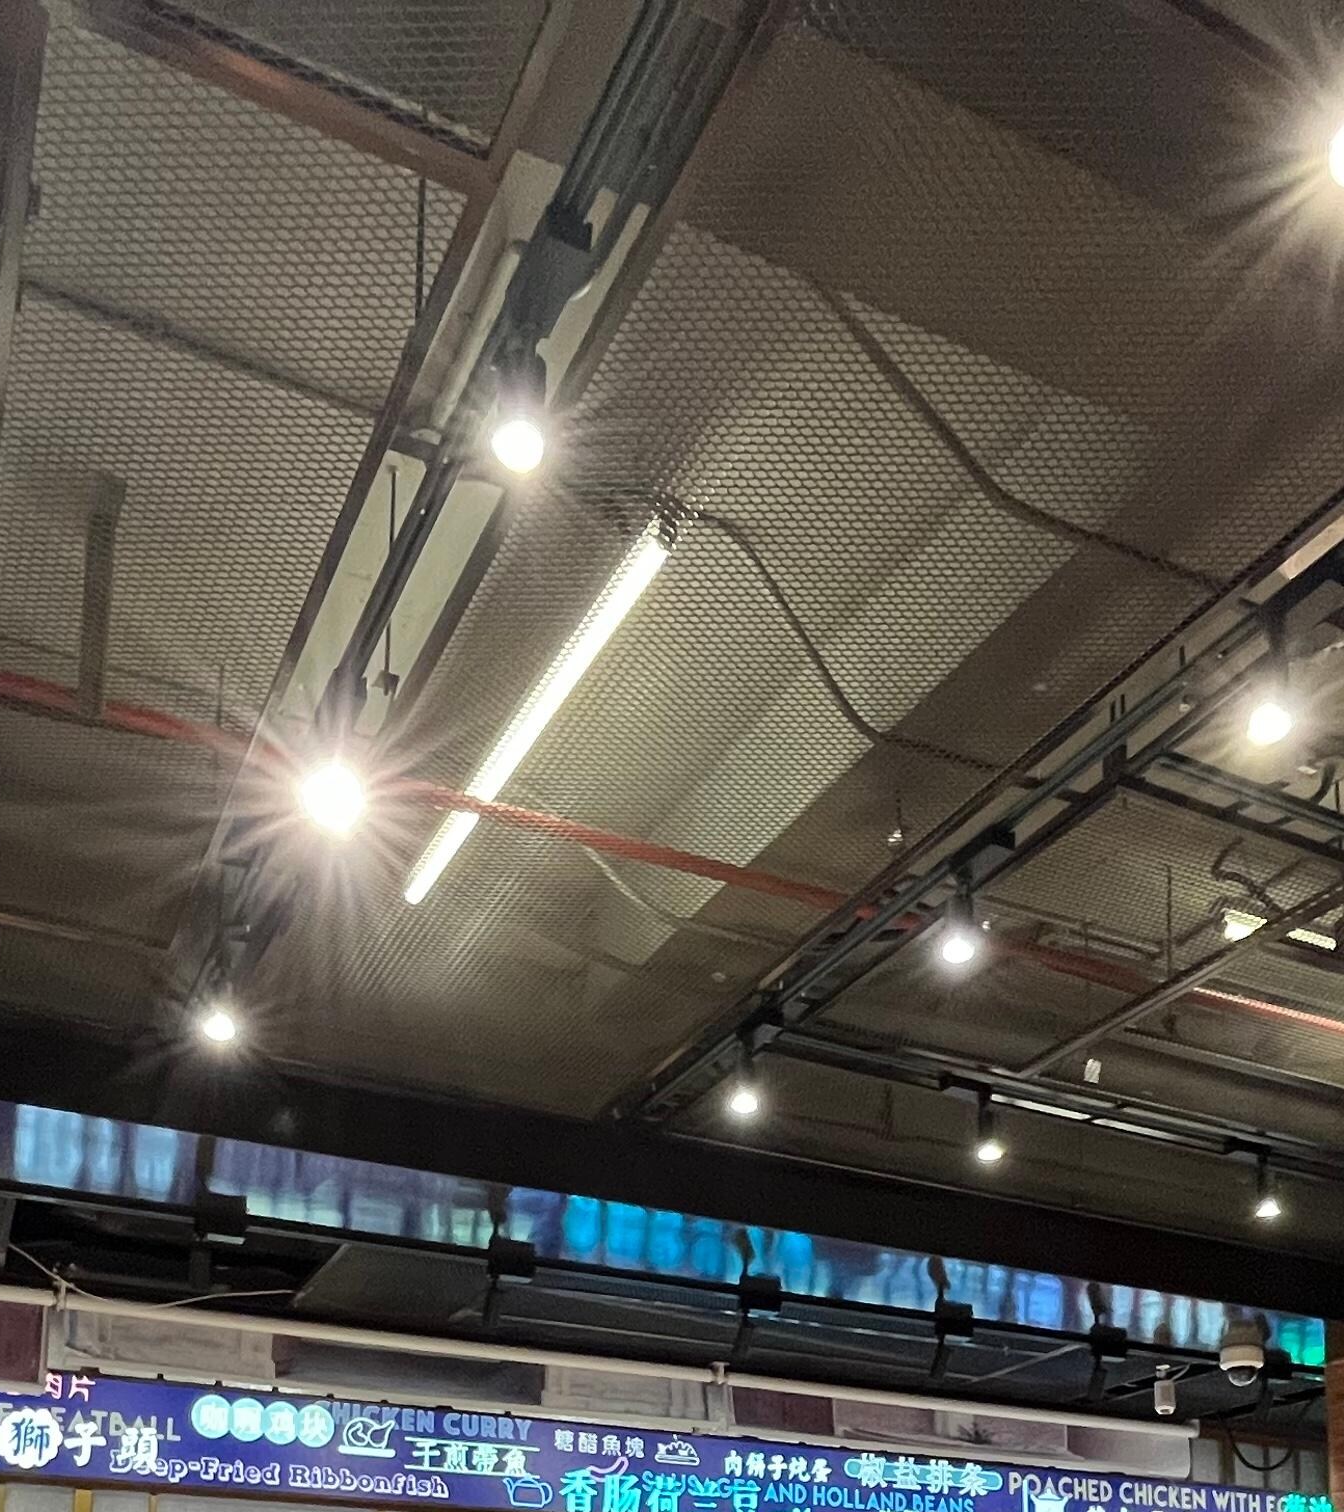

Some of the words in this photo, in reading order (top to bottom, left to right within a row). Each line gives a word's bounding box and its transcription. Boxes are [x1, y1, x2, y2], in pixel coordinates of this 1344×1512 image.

[22, 1406, 182, 1442] EATBALL
[442, 1411, 532, 1441] CURRY
[288, 1464, 450, 1500] Ribbonfish
[763, 1482, 807, 1506] AND
[812, 1485, 907, 1512] HOLLAND
[1008, 1471, 1113, 1503] POACHED
[1118, 1481, 1207, 1510] CHICKEN
